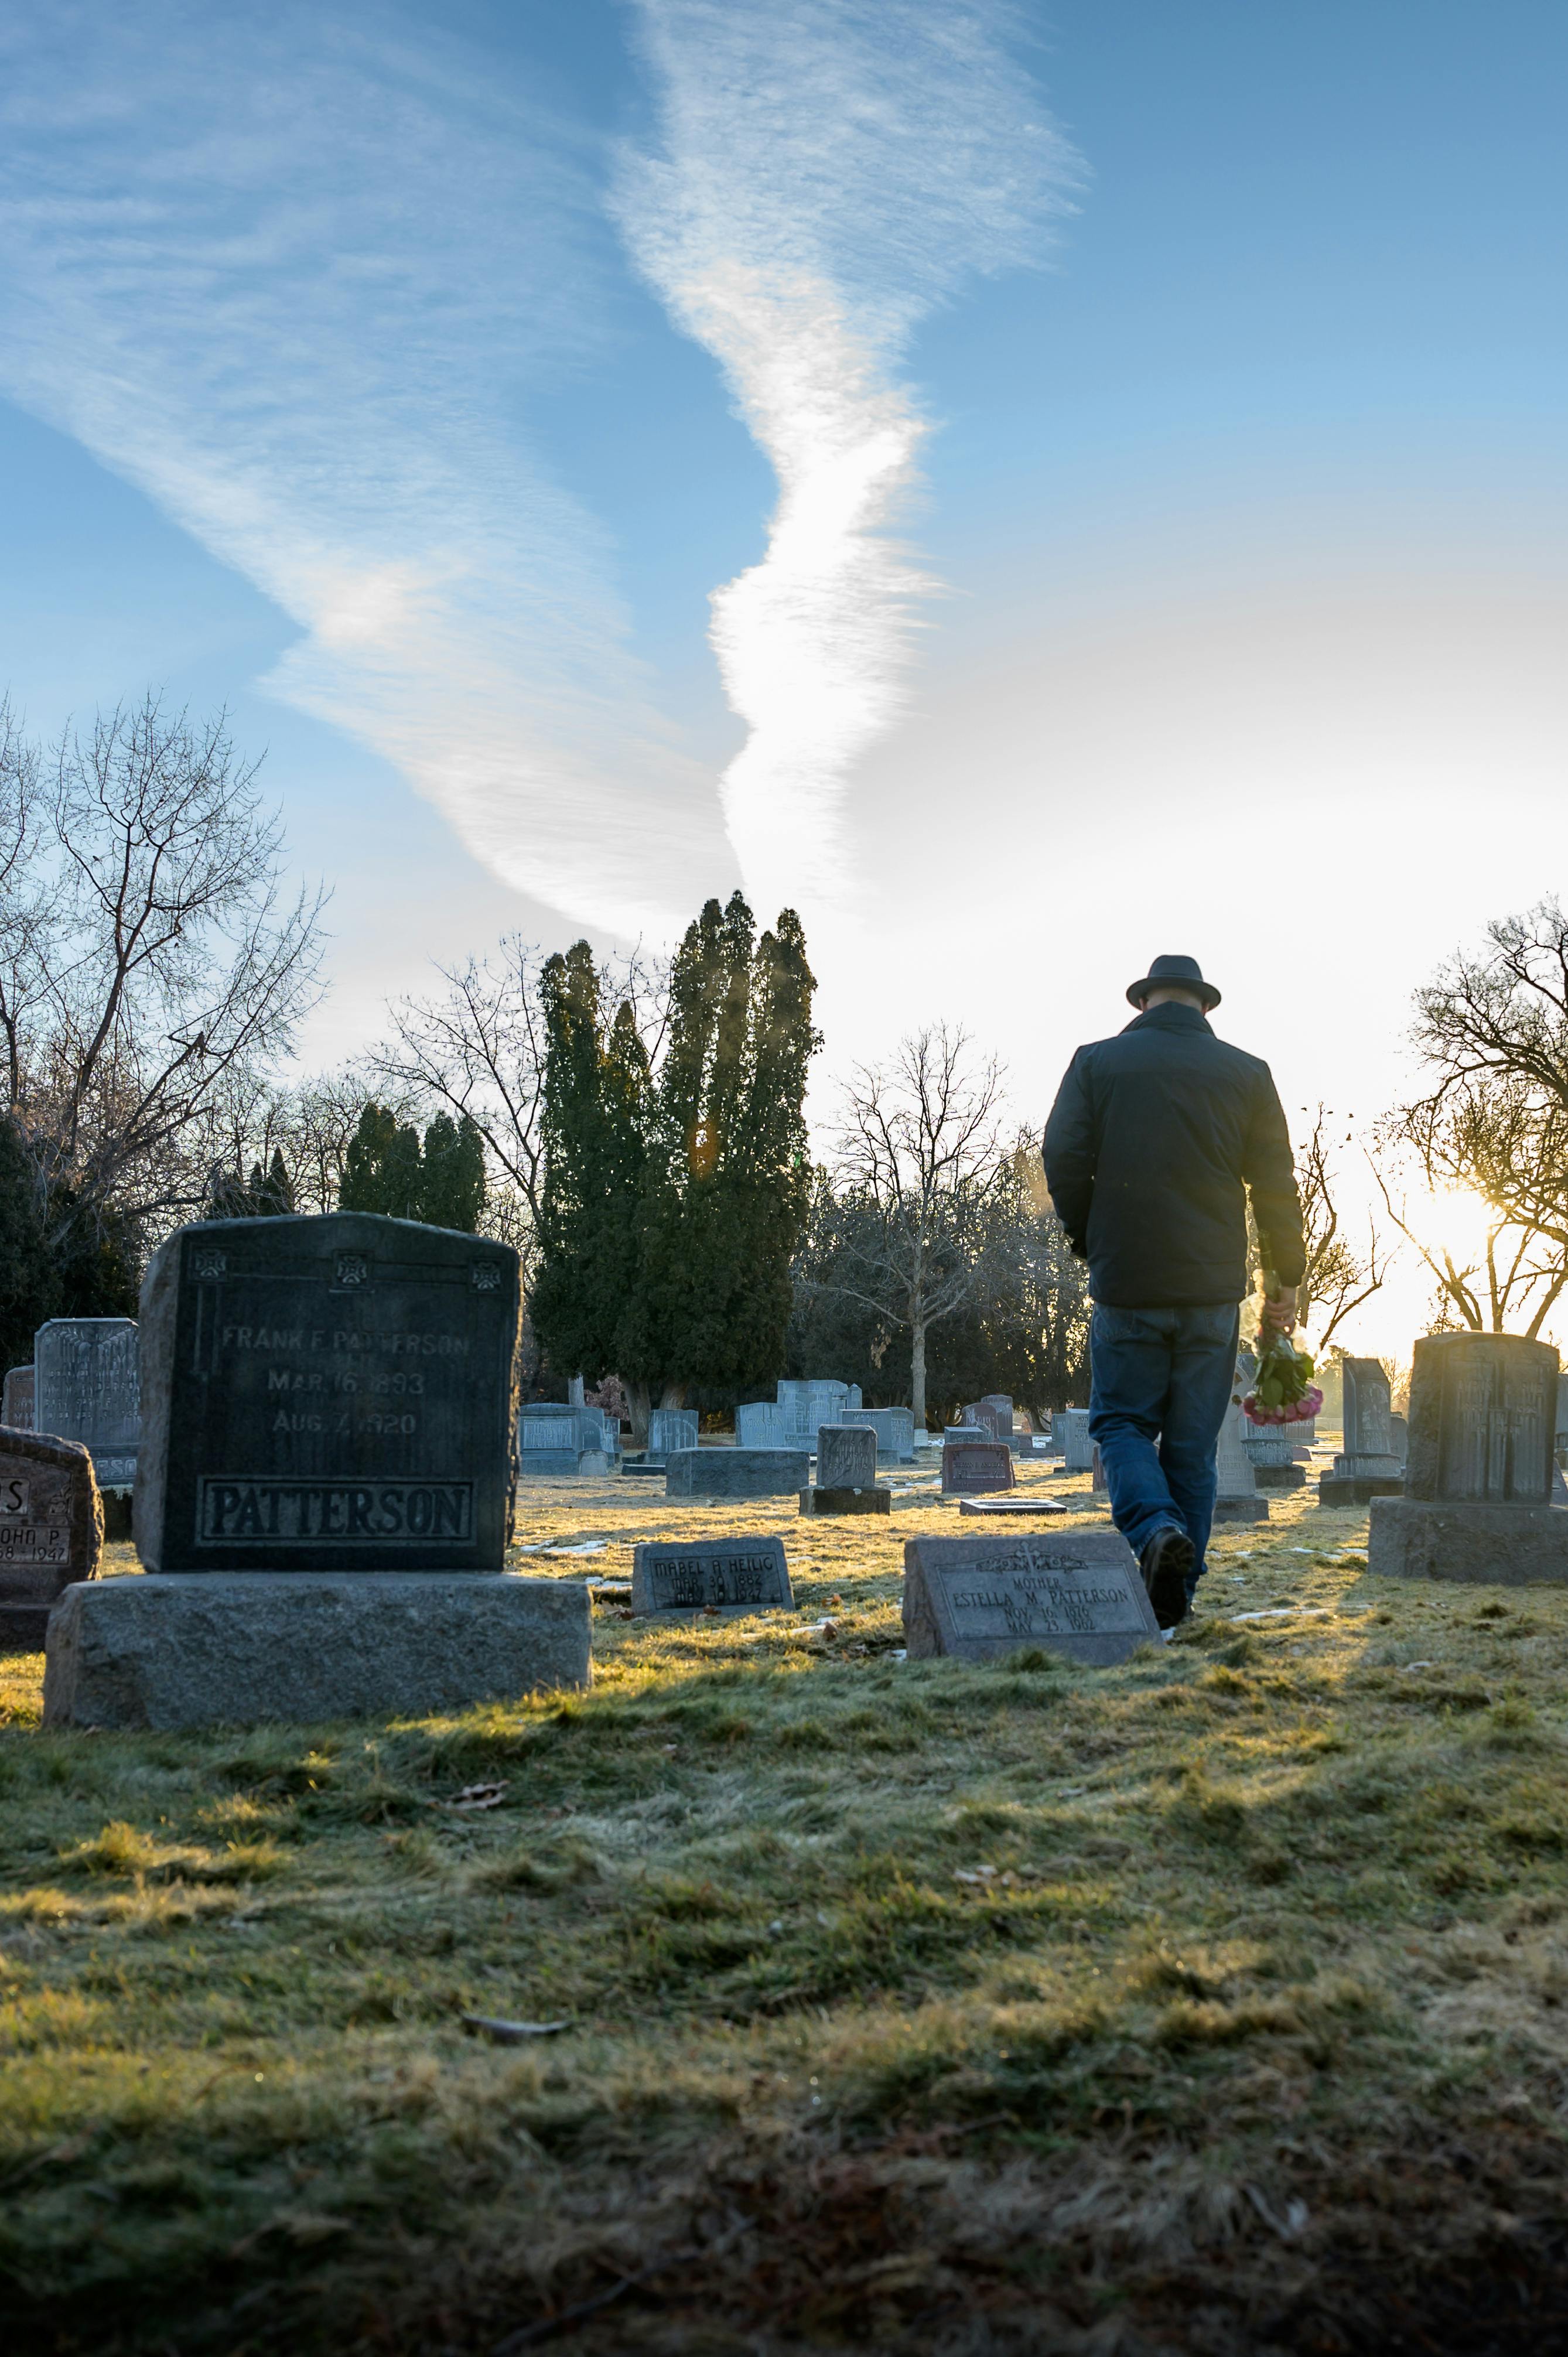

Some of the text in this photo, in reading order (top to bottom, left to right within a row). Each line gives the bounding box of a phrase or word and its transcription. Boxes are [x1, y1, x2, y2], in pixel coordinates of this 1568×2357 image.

[222, 1327, 304, 1350] FRANK
[334, 1331, 470, 1357] PATTERSON
[370, 1372, 425, 1395] 1893
[210, 1487, 466, 1535] PATTERSON
[32, 1548, 65, 1561] 1947
[654, 1560, 704, 1577] MABEL
[728, 1557, 773, 1574] HEILIG
[734, 1574, 762, 1591] 1882
[1013, 1577, 1063, 1590] MOTHER
[953, 1593, 1013, 1608] ESTELLA
[1048, 1588, 1128, 1605] PATTERSON
[1064, 1605, 1089, 1620] 1876
[1007, 1619, 1032, 1634] MAY
[1069, 1618, 1096, 1631] 1962
